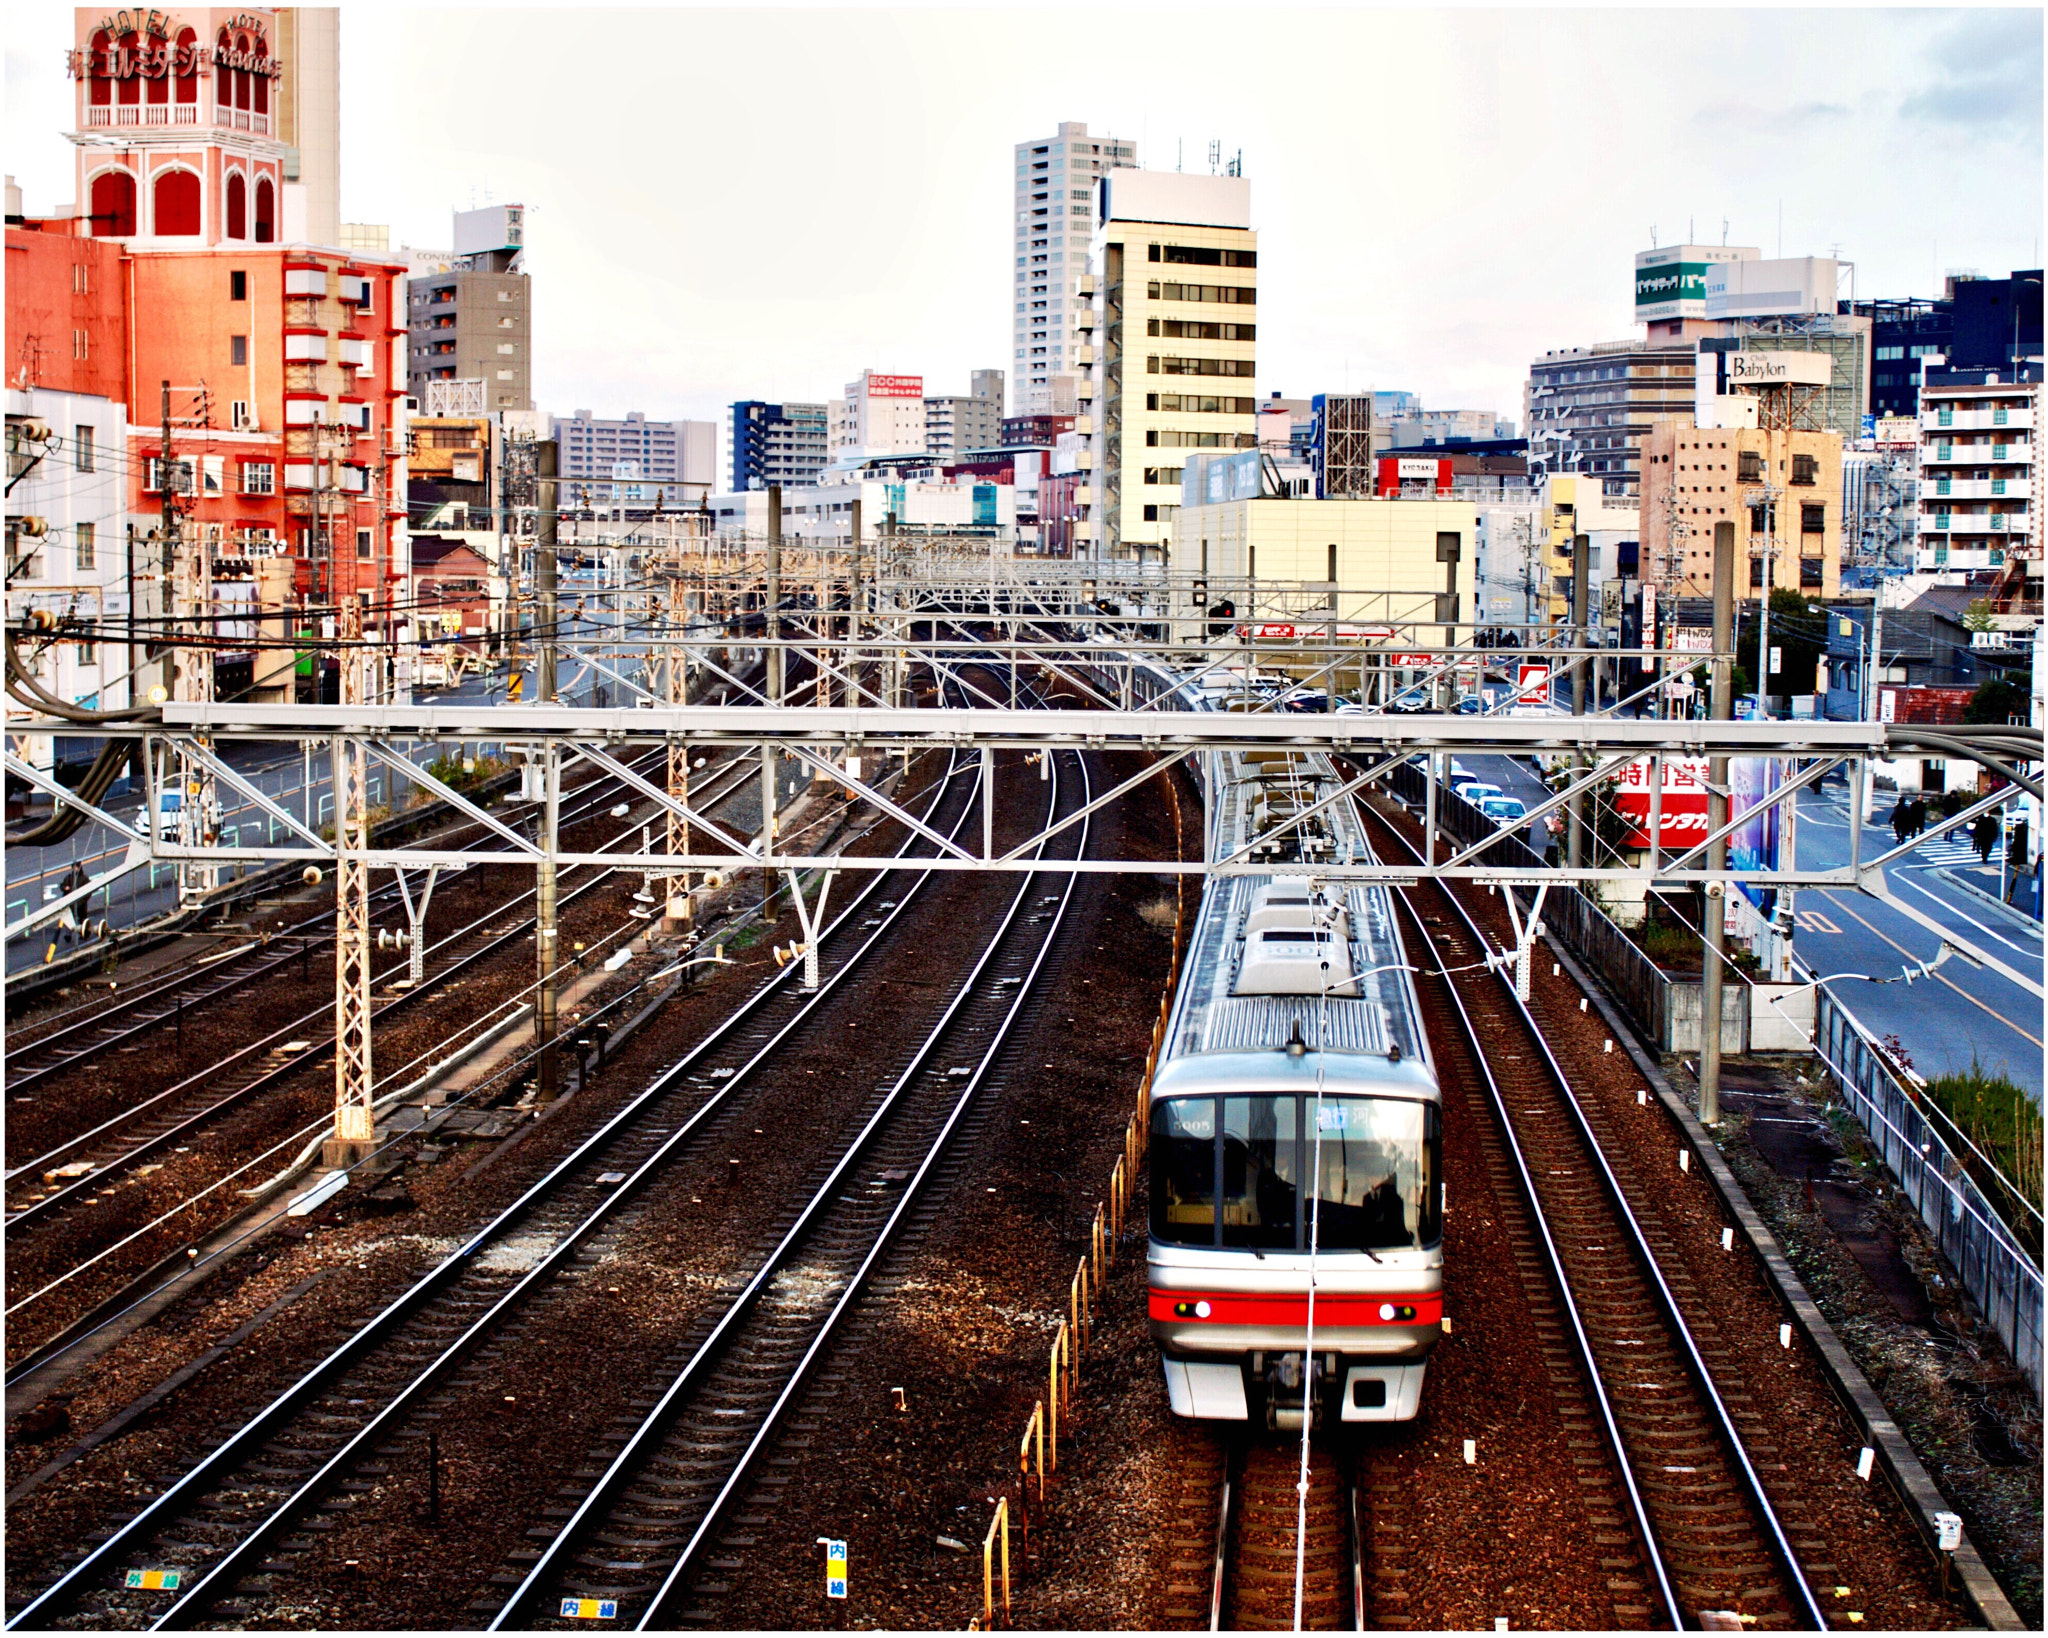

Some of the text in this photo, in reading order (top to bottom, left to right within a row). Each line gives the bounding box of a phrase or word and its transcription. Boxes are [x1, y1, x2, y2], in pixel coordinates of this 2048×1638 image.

[101, 7, 169, 41] HOTEL
[225, 13, 267, 40] HOTEL
[1733, 357, 1786, 379] Babylon
[831, 1544, 845, 1595] 内線
[562, 1600, 615, 1617] 内線
